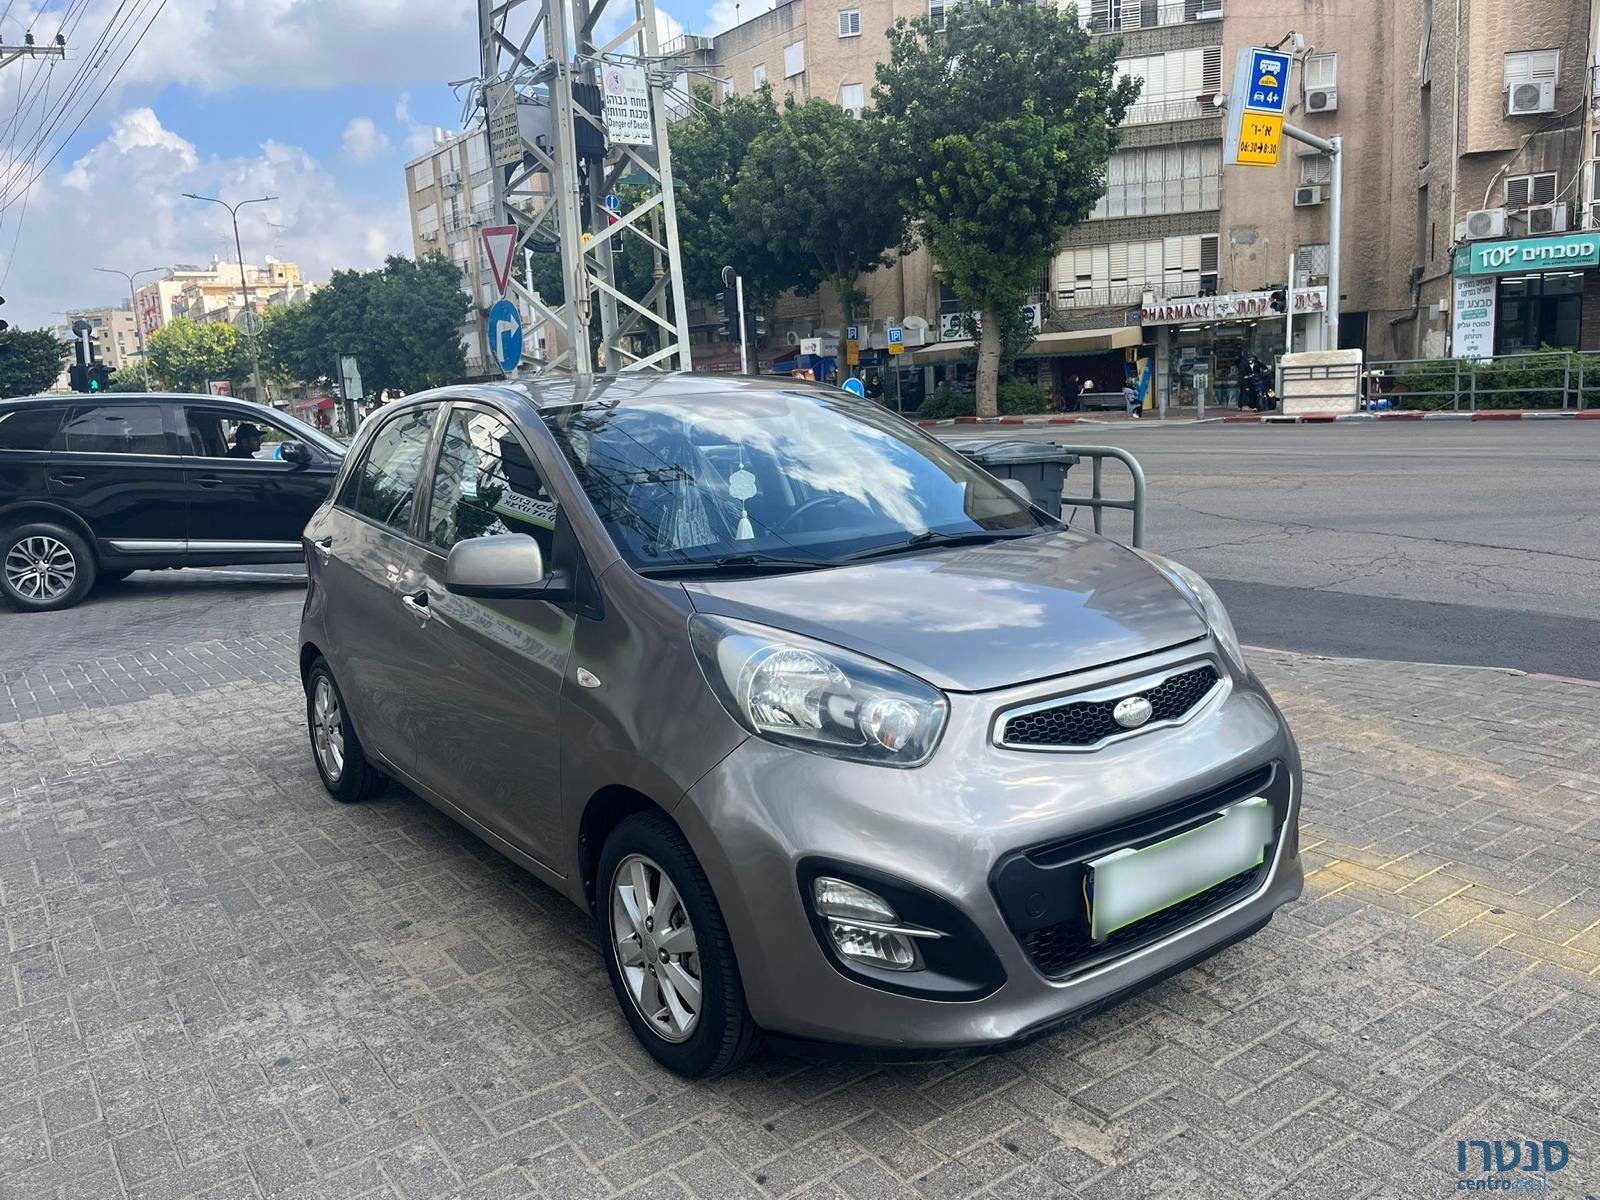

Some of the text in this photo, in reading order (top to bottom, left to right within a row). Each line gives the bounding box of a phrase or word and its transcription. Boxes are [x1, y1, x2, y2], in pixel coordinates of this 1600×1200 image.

[606, 95, 647, 107] מתח גבוה!
[1266, 91, 1279, 103] 4+
[607, 107, 648, 119] סכנת מוות!
[608, 118, 627, 129] Danger
[1478, 245, 1519, 268] TOP
[1522, 242, 1596, 261] מטבחים
[1294, 293, 1324, 310] בית
[1468, 299, 1492, 309] מבצע
[1141, 303, 1210, 321] PHARMACY
